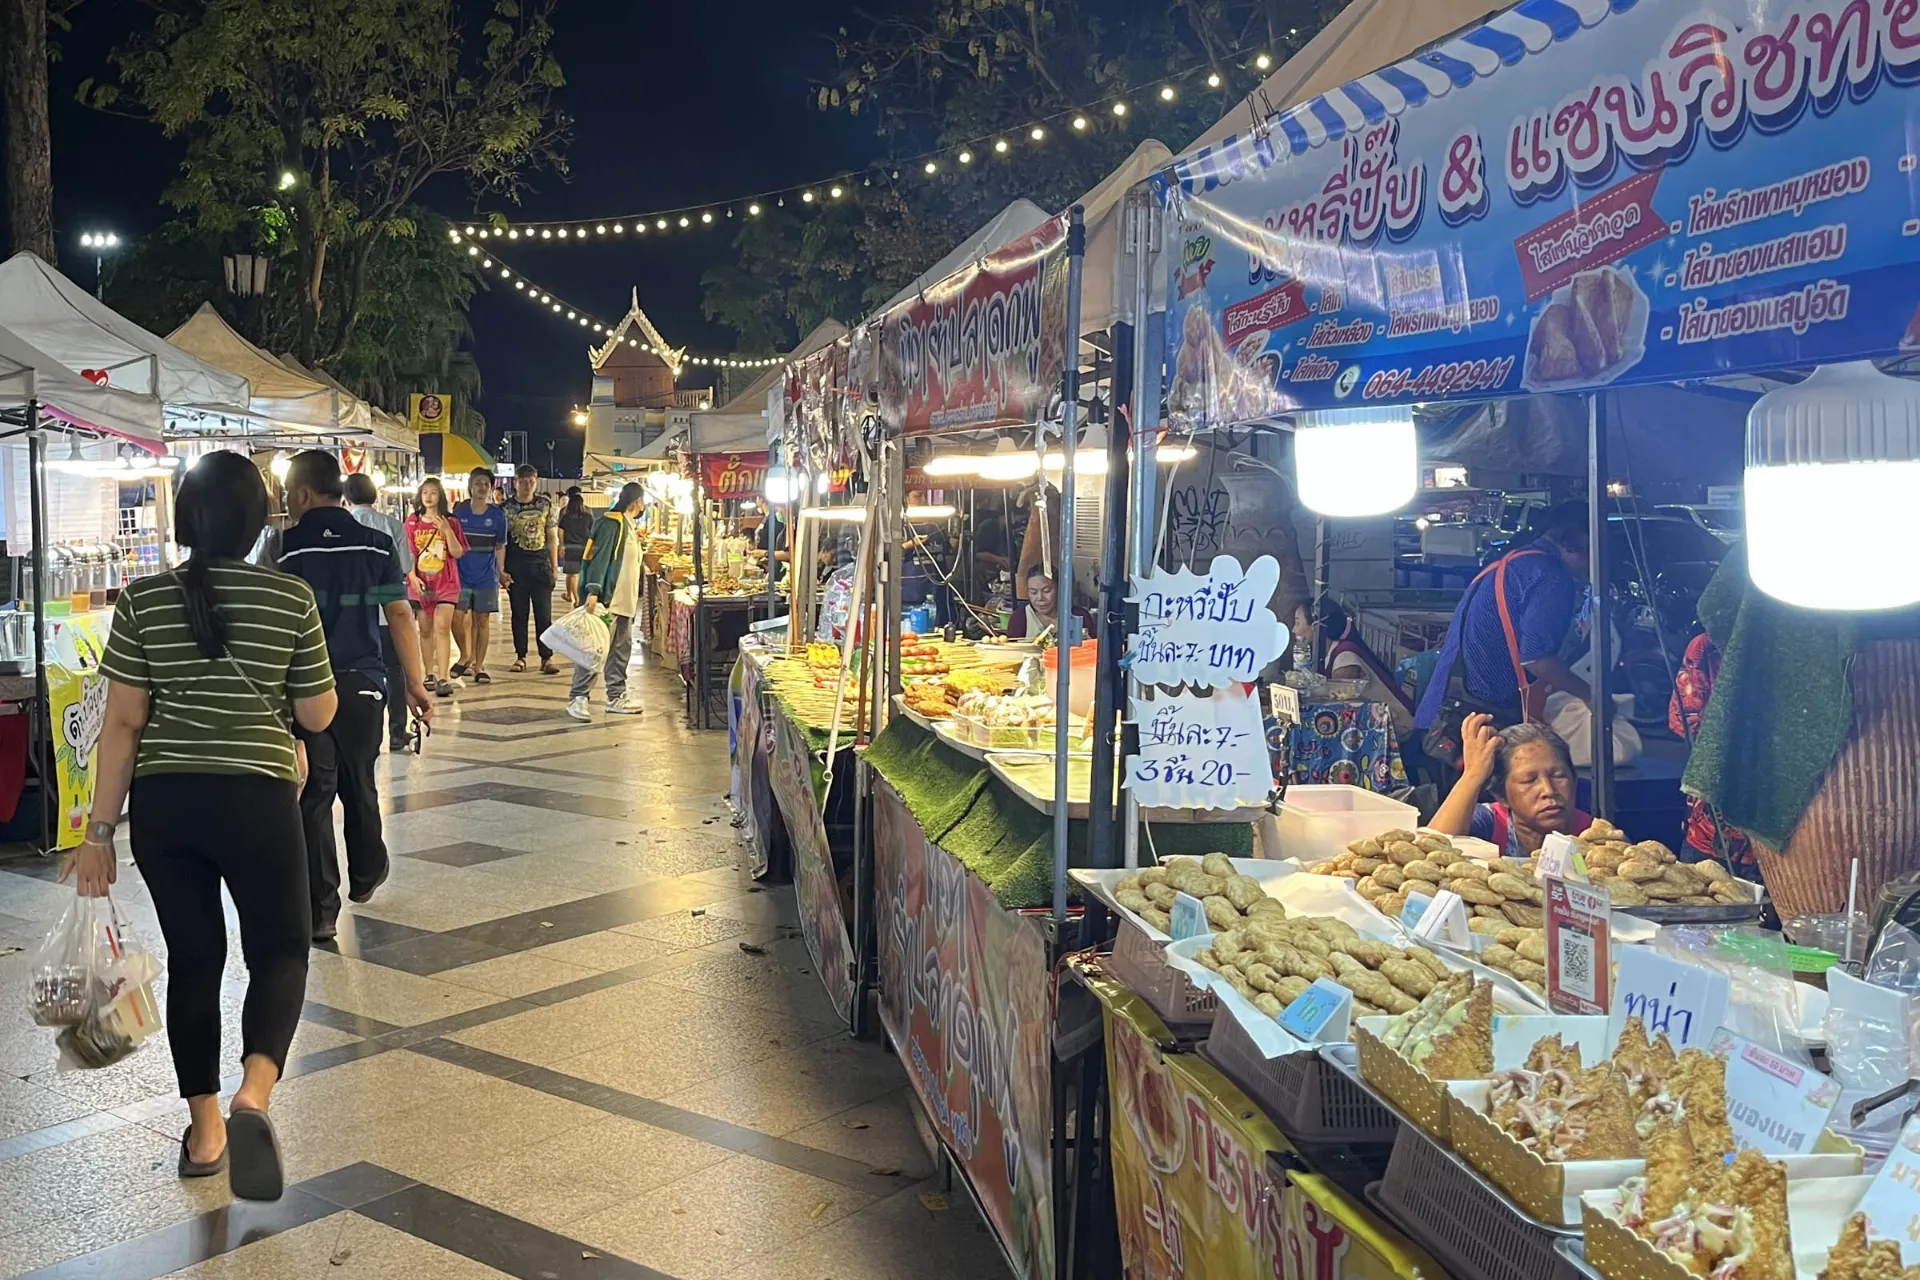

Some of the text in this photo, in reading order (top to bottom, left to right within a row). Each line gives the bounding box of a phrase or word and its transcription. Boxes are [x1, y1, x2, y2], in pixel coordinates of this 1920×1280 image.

[1441, 131, 1480, 206] &
[1363, 355, 1515, 399] 064-4492941
[1207, 642, 1255, 673] บาท
[1136, 760, 1158, 781] 3
[1624, 982, 1693, 1045] ทน่า
